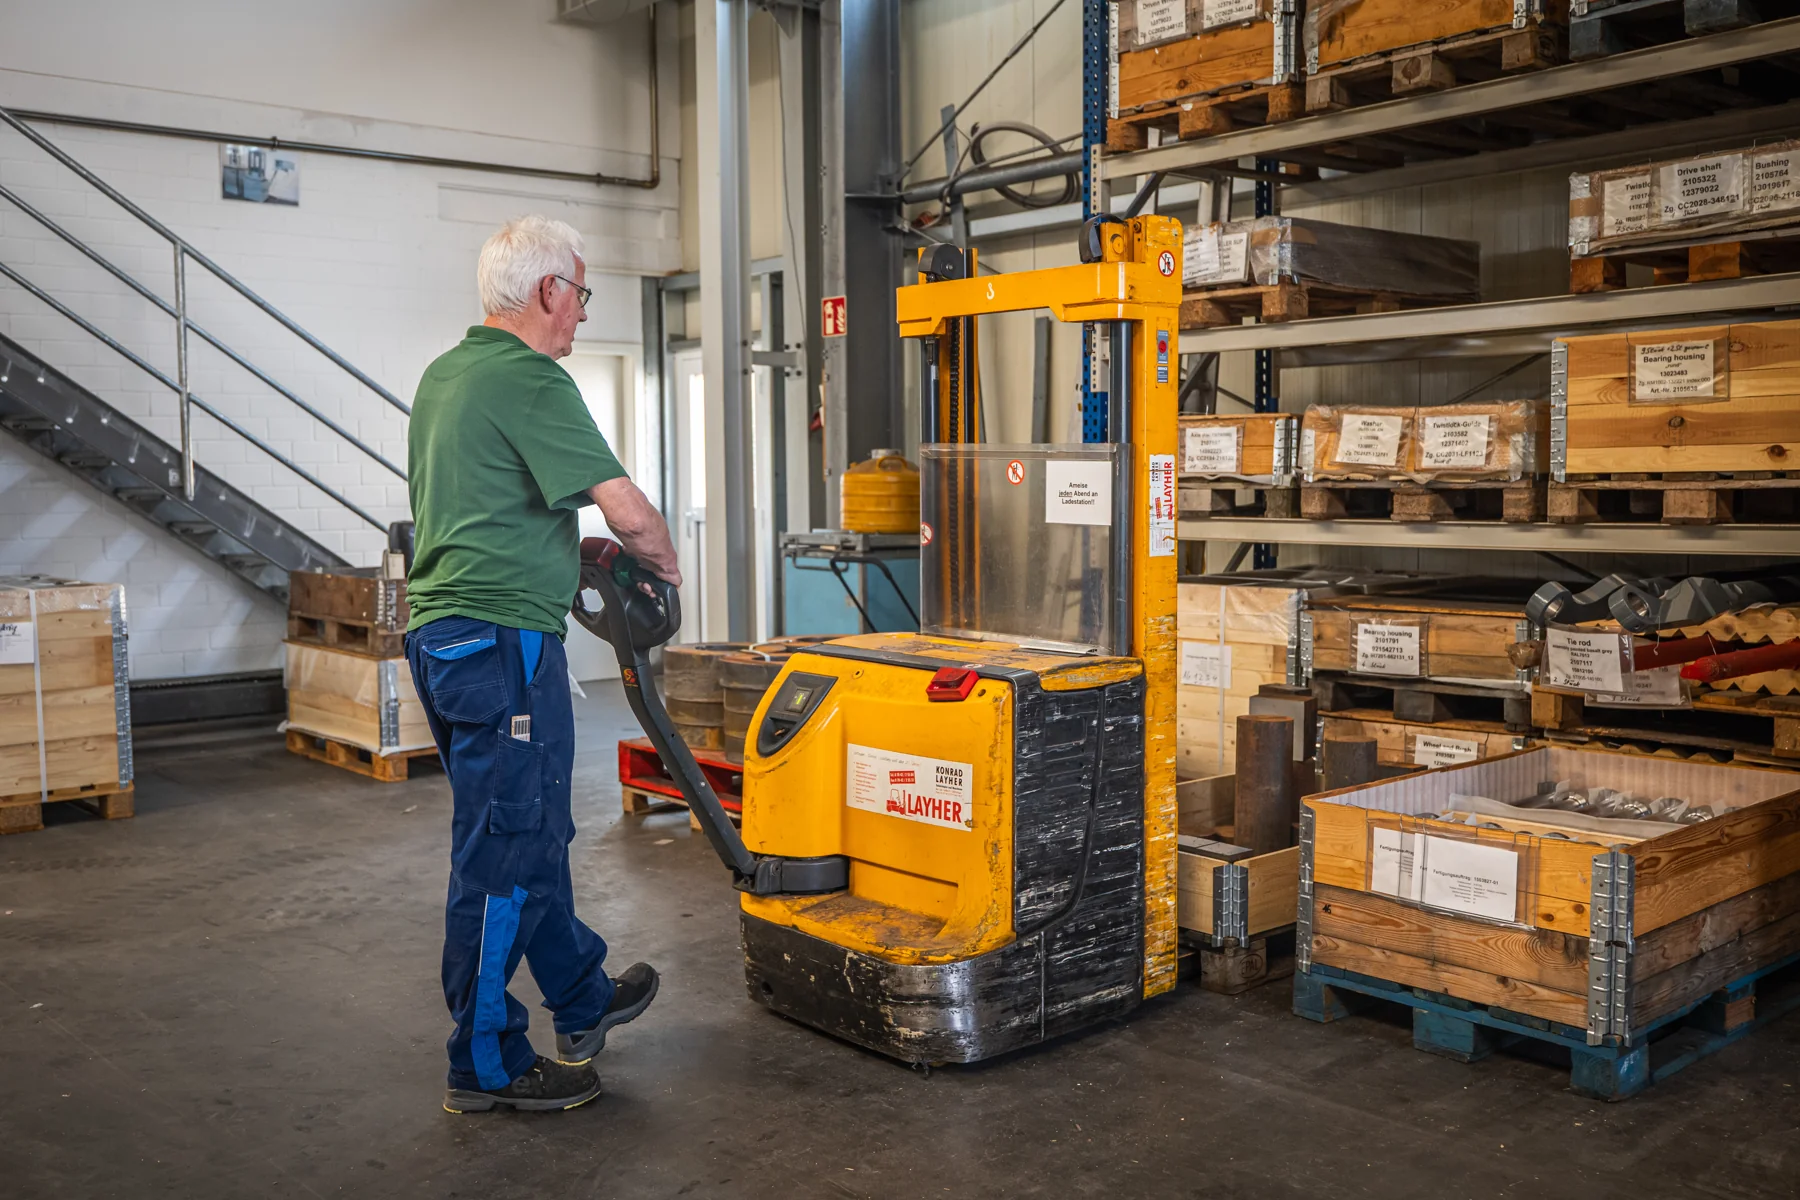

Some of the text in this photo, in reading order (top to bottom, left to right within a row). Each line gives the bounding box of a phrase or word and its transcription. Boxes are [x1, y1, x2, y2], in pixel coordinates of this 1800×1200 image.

[1677, 162, 1722, 176] Drive shaft
[1755, 159, 1790, 170] Bushing
[1683, 174, 1717, 186] 2105322
[1755, 169, 1789, 181] 2105764
[1681, 184, 1719, 197] 12379022
[1643, 353, 1705, 363] Bearing housing
[1163, 461, 1173, 503] LAYHER
[1058, 490, 1073, 498] jeden
[1363, 628, 1413, 638] Bearing housing
[1566, 637, 1577, 645] Tie
[1423, 740, 1442, 748] Wheel
[935, 765, 963, 777] KONRAD
[935, 774, 963, 787] LAYHER
[907, 793, 962, 823] LAYHER
